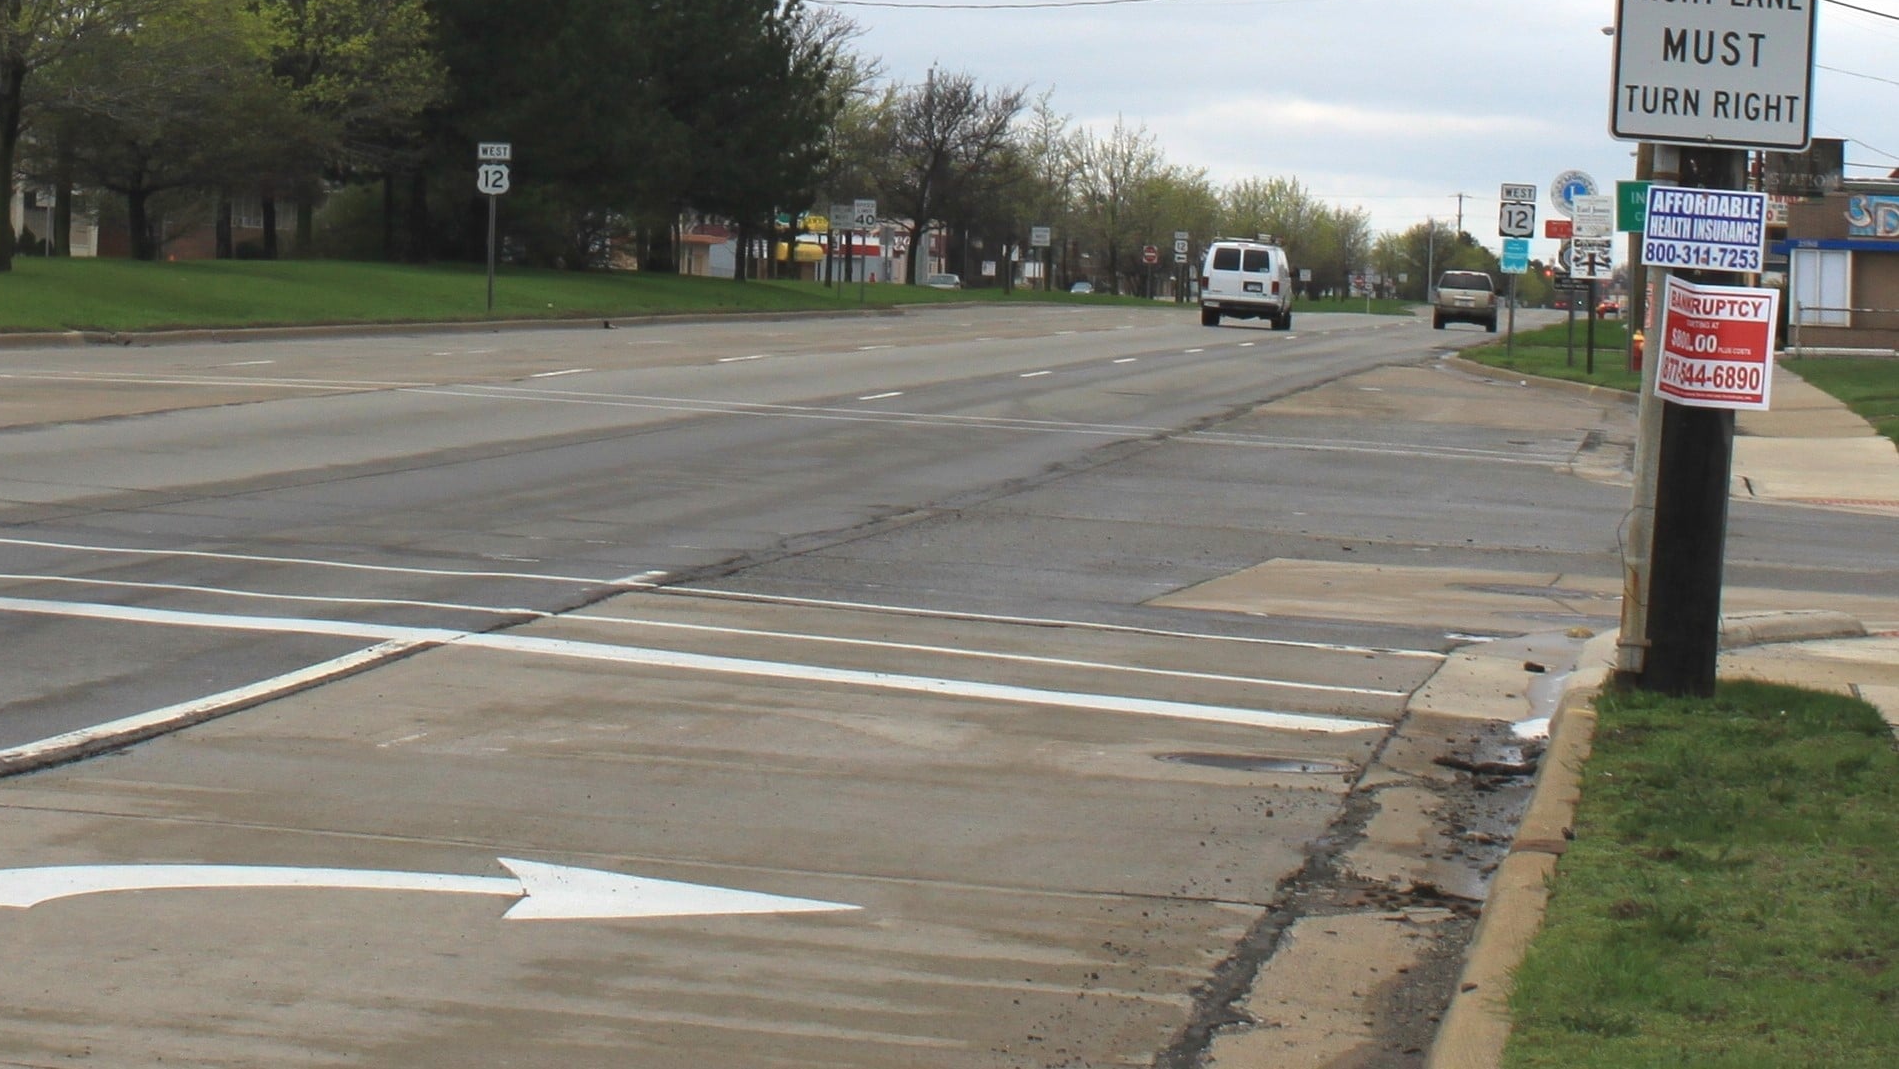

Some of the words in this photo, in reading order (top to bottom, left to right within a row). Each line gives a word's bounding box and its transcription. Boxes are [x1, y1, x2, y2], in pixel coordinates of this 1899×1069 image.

[1662, 27, 1766, 68] MUST
[1625, 84, 1700, 117] TURN
[1713, 90, 1799, 123] RIGHT
[481, 146, 509, 157] WEST
[484, 170, 504, 188] 12
[1505, 187, 1533, 198] WEST
[1652, 190, 1760, 219] AFFORDABLE
[855, 214, 875, 226] 40
[1506, 210, 1528, 229] 12
[1649, 214, 1692, 240] HEALTH
[1693, 218, 1760, 245] INSURANCE
[1645, 242, 1759, 270] 800-311-7253
[1670, 290, 1763, 318] BANKRUPTCY
